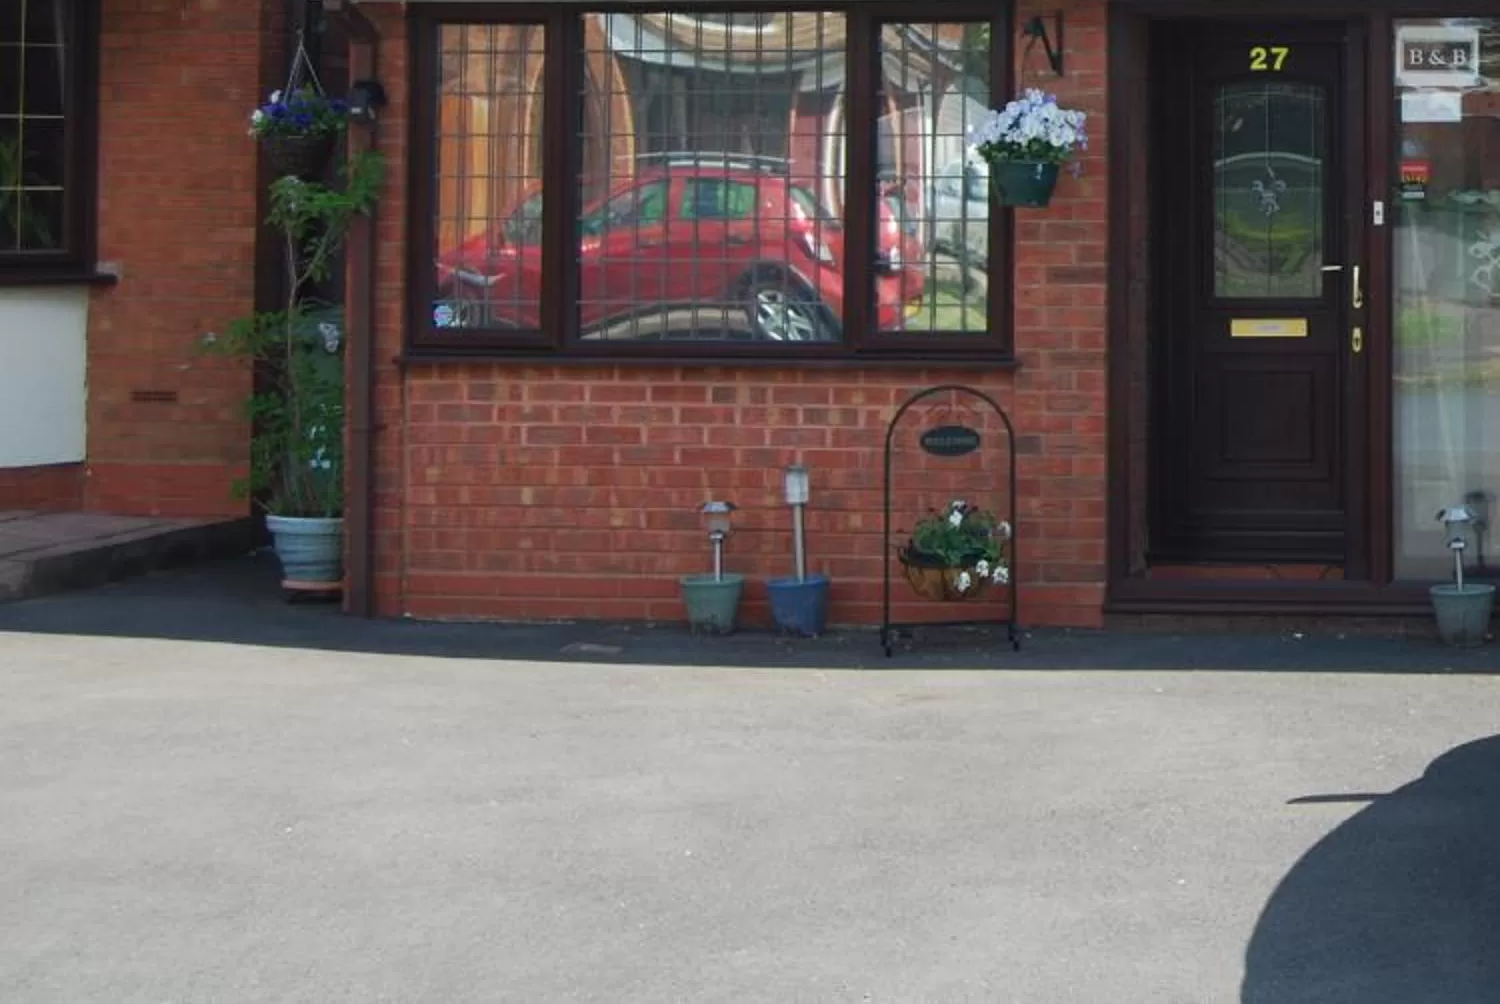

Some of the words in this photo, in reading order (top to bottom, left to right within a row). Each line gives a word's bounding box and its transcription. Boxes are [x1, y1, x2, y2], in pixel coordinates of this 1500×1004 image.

[1250, 46, 1289, 71] 27
[1409, 48, 1423, 65] B
[1428, 48, 1446, 65] &
[1452, 48, 1466, 65] B
